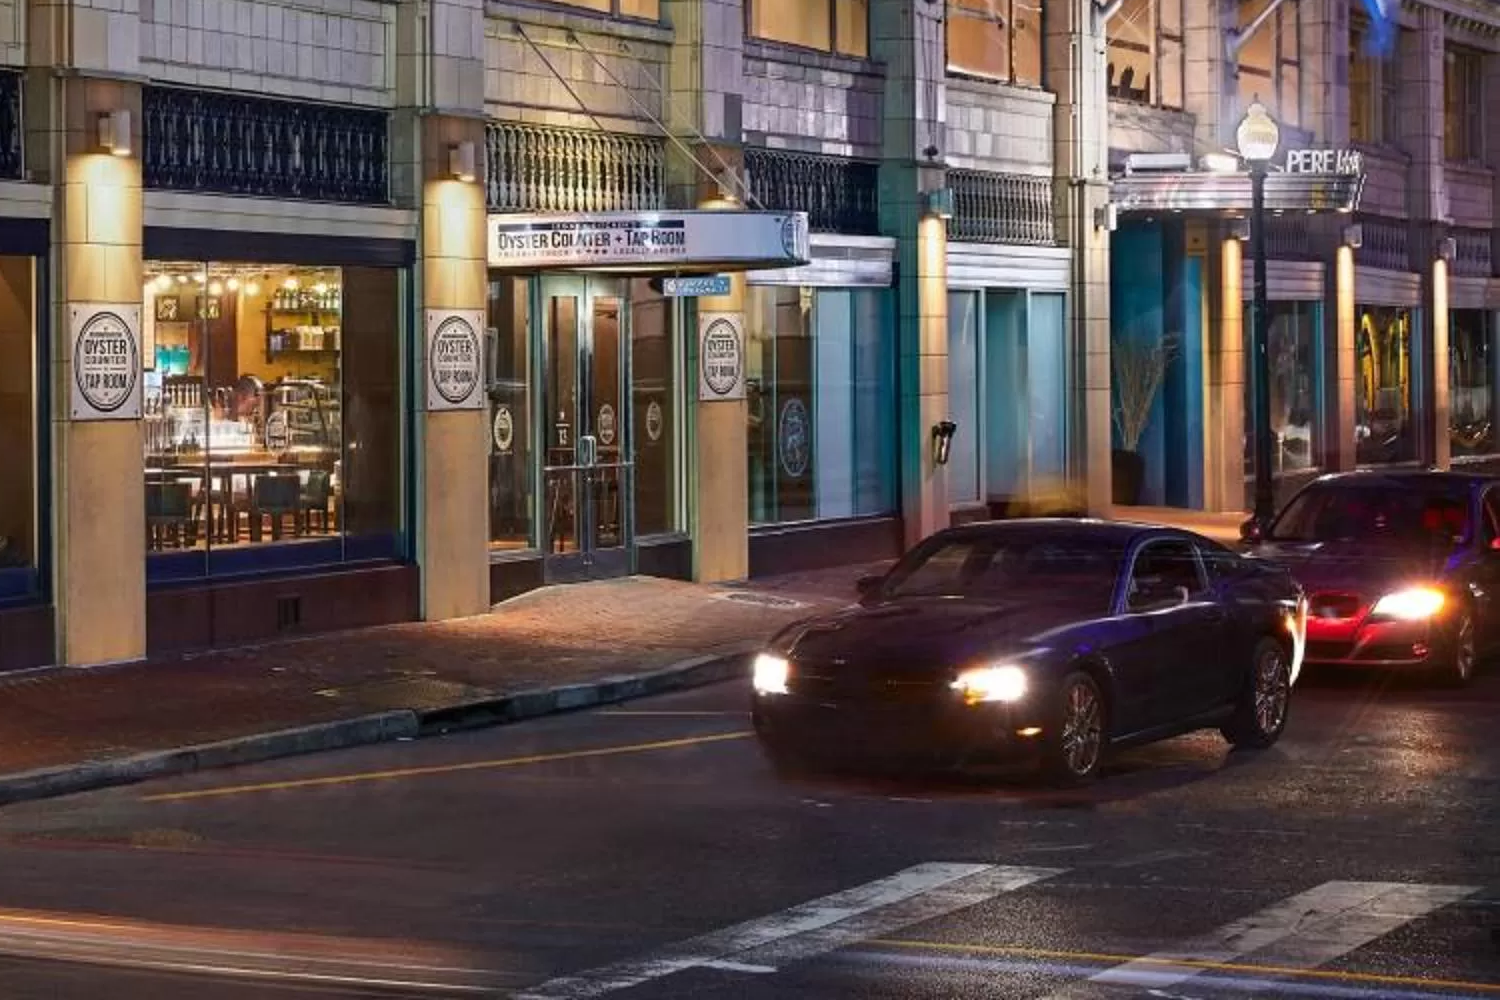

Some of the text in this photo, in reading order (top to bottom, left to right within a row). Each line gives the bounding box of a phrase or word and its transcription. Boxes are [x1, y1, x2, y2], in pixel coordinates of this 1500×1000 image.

[1286, 149, 1334, 173] PERE
[499, 233, 549, 250] OYSTER
[624, 229, 650, 246] TAP
[652, 228, 685, 246] ROOM
[84, 339, 127, 354] OYSTER
[438, 339, 472, 353] OYSTER
[84, 355, 127, 364] COUNTER
[84, 373, 127, 389] TAP ROOM
